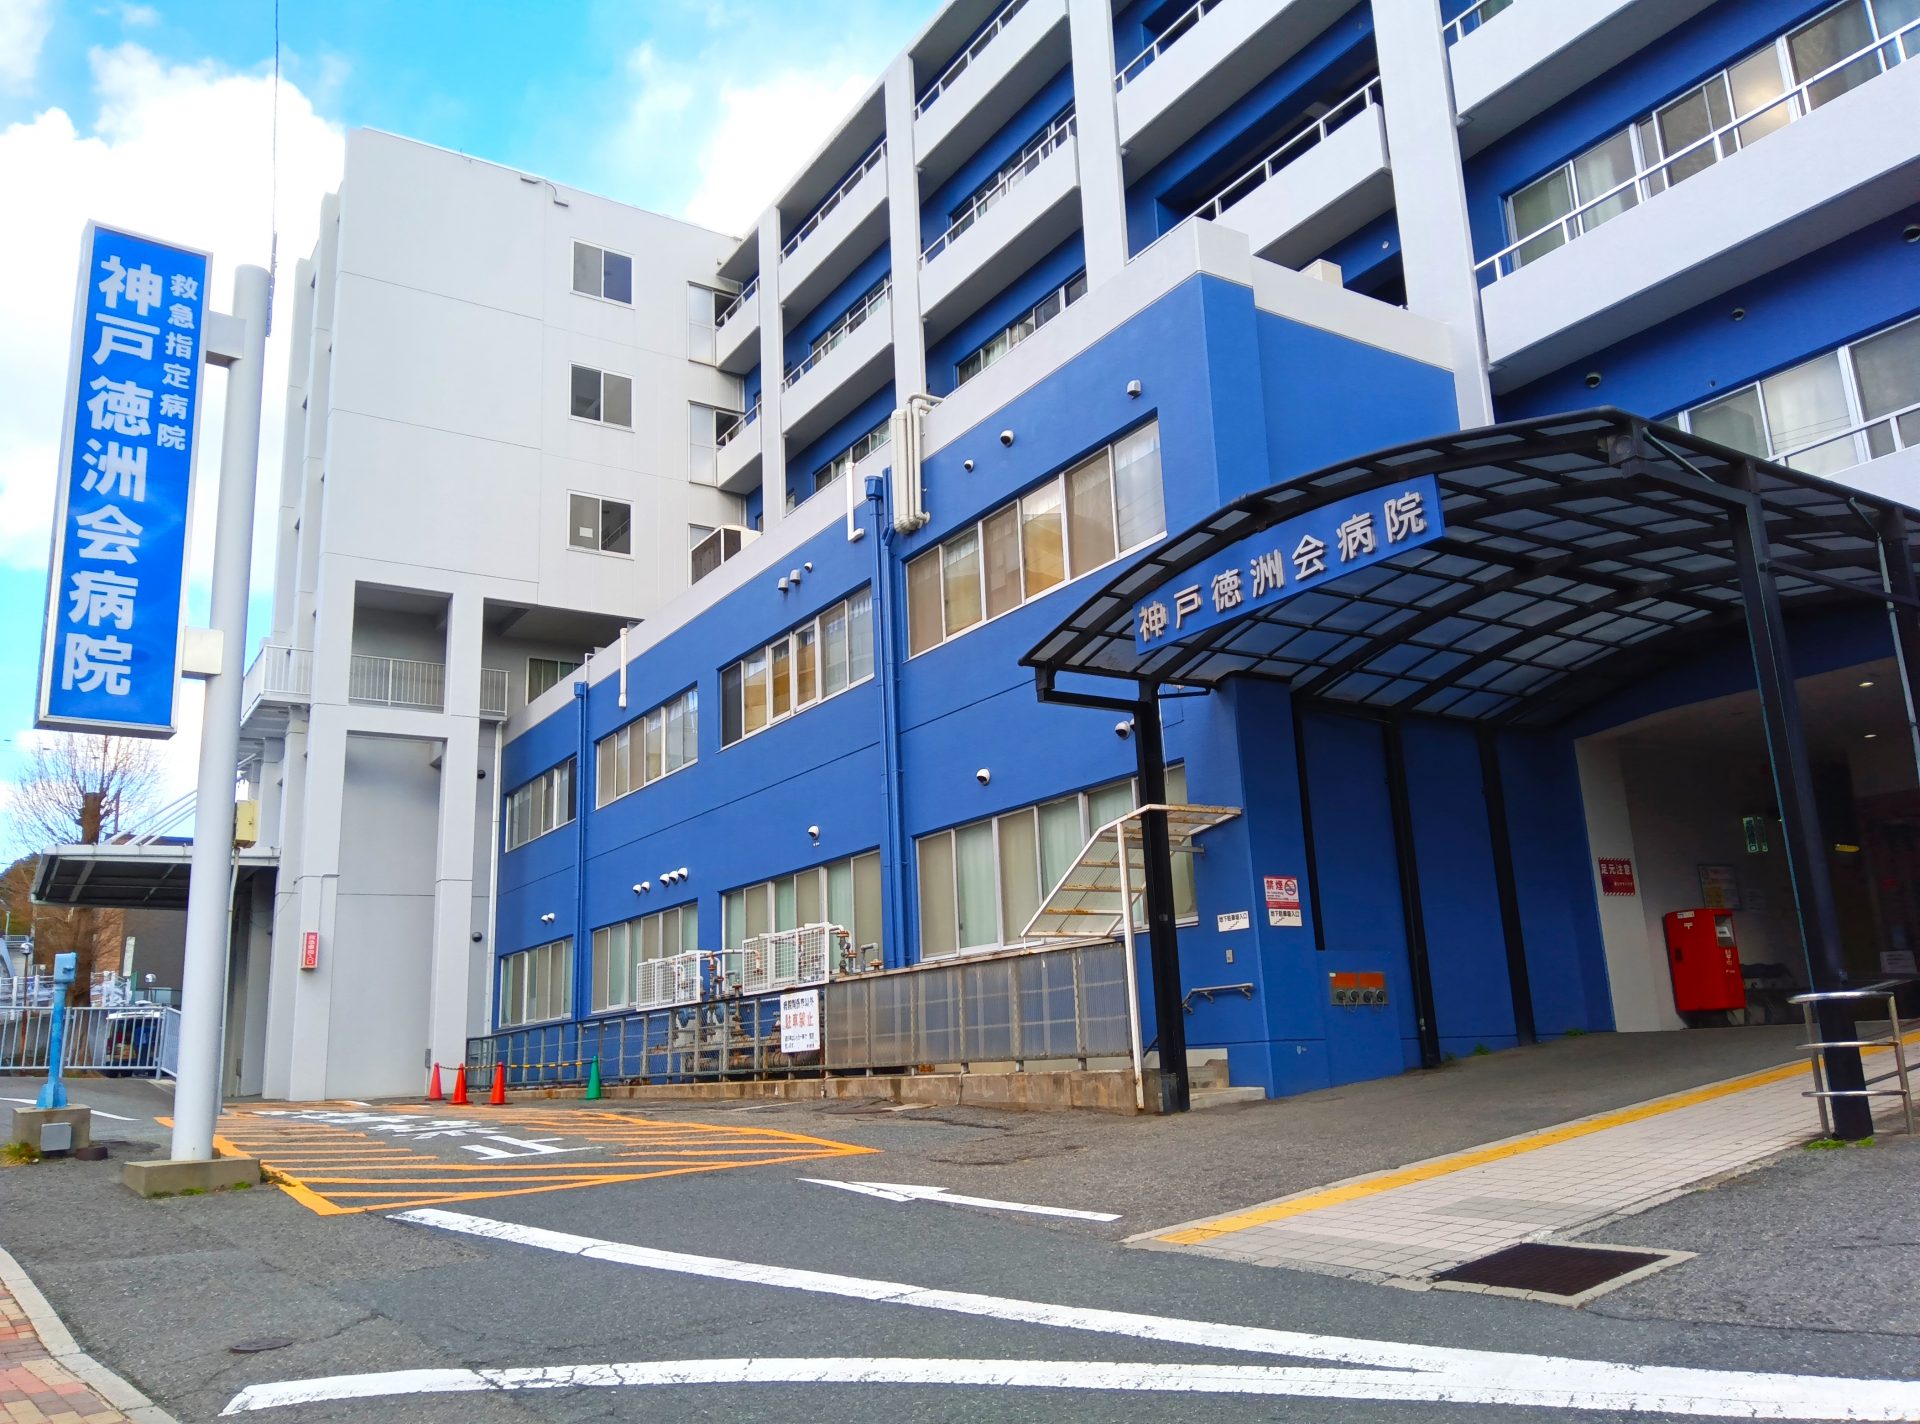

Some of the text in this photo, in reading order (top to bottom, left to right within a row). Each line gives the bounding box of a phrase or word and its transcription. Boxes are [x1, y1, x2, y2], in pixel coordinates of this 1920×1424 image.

[156, 273, 199, 452] 救急指定病院
[61, 255, 164, 696] 神戸徳洲会病院
[1138, 490, 1428, 642] 神戸徳洲会病院
